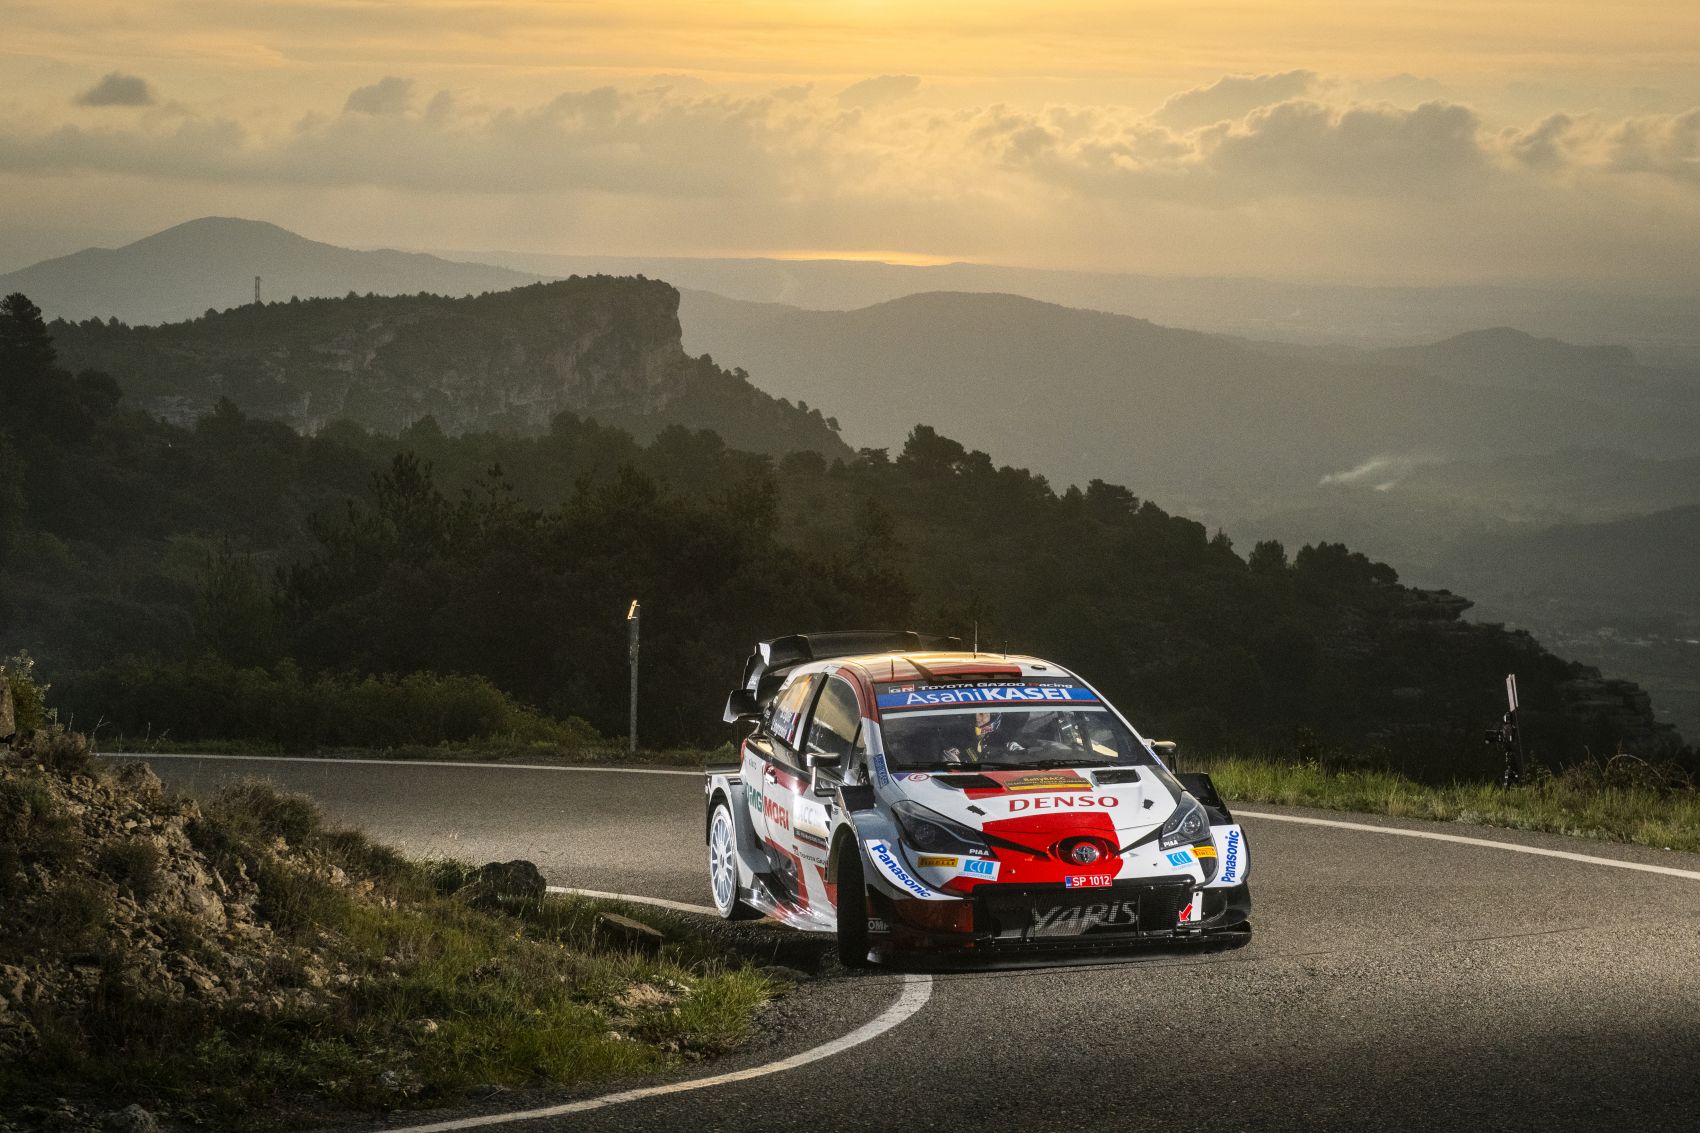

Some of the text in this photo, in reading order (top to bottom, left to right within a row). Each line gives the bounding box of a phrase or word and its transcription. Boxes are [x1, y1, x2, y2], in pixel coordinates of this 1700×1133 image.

[918, 683, 974, 691] TOYOTA
[1009, 796, 1119, 812] DENSO
[764, 795, 789, 831] MORI
[968, 848, 990, 856] PIAA
[1163, 840, 1179, 848] PIAA
[1221, 830, 1240, 883] Panasonic
[871, 844, 932, 898] Panasonic
[1072, 875, 1110, 887] SP 1012
[1030, 900, 1136, 934] YARIS
